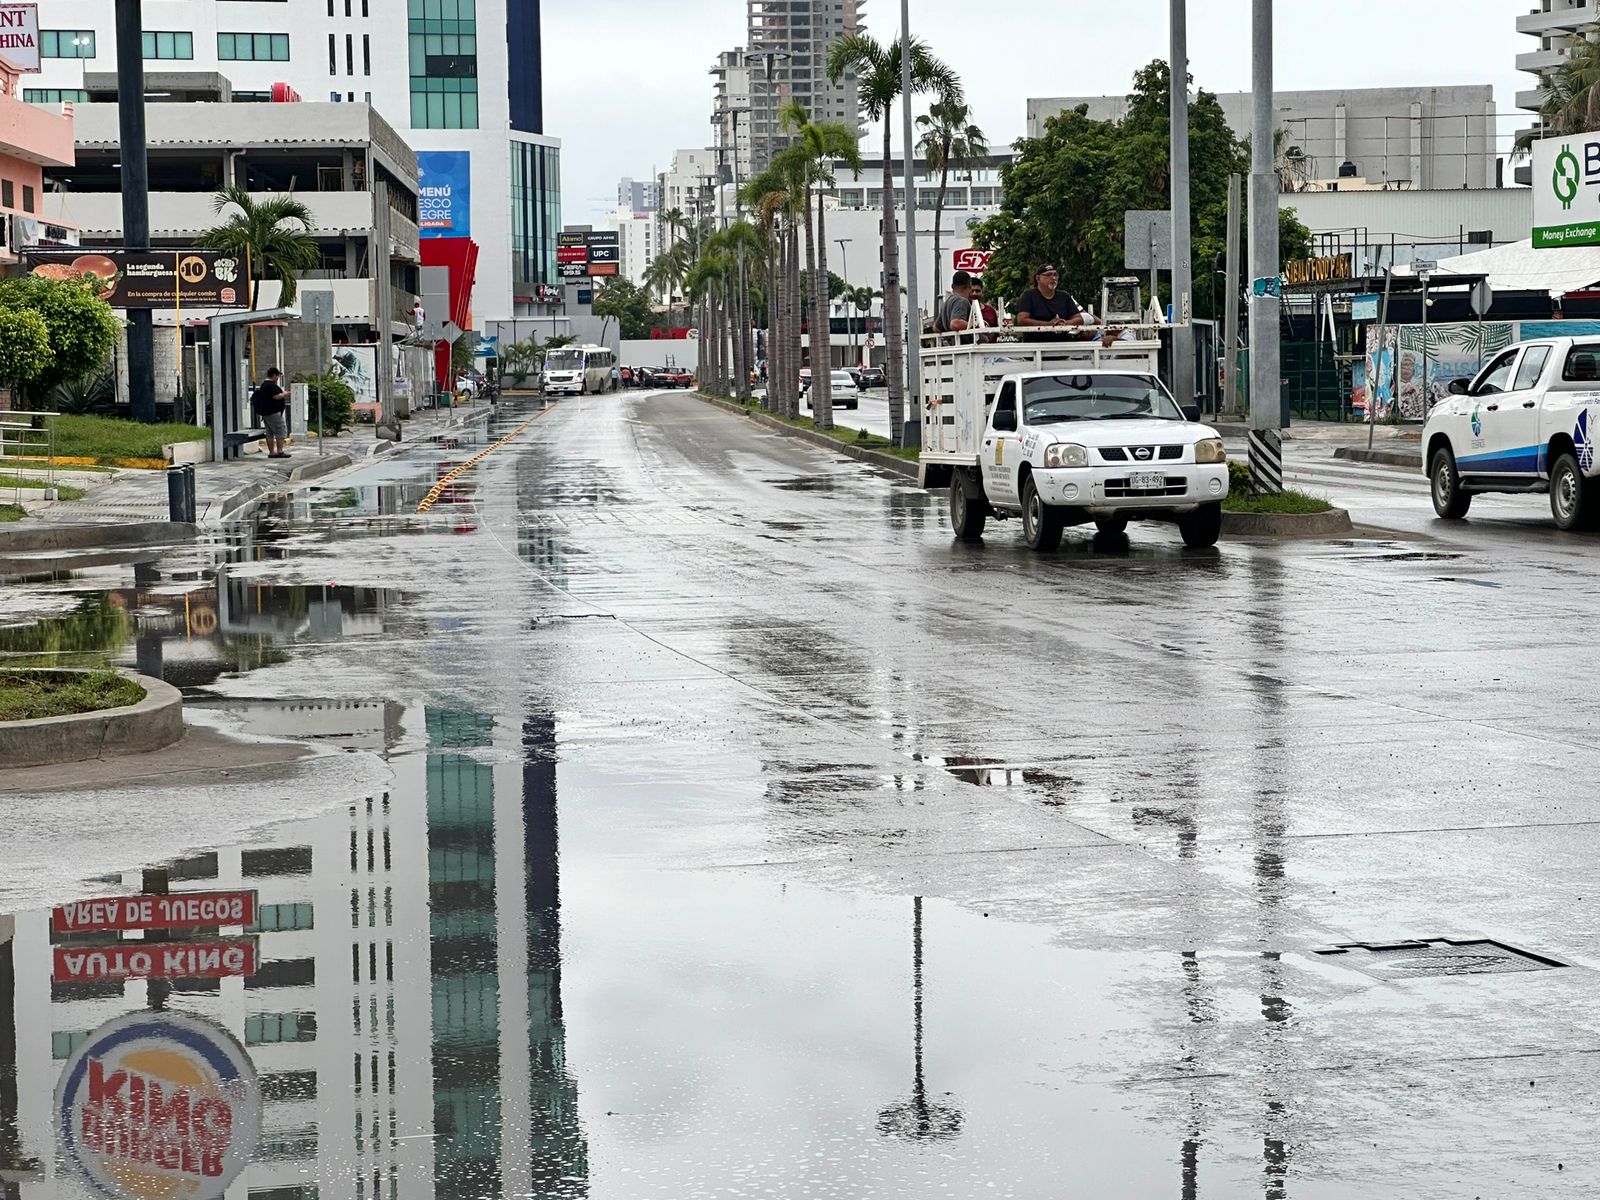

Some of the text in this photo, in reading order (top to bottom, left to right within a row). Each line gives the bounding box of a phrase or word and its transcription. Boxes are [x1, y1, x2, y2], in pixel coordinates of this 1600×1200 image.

[418, 184, 451, 197] MENÚ
[420, 209, 452, 220] EGRE
[1542, 227, 1597, 241] Money Exchange
[127, 269, 173, 277] hamburguesa
[136, 263, 164, 271] segunda
[1311, 258, 1329, 281] FOOD
